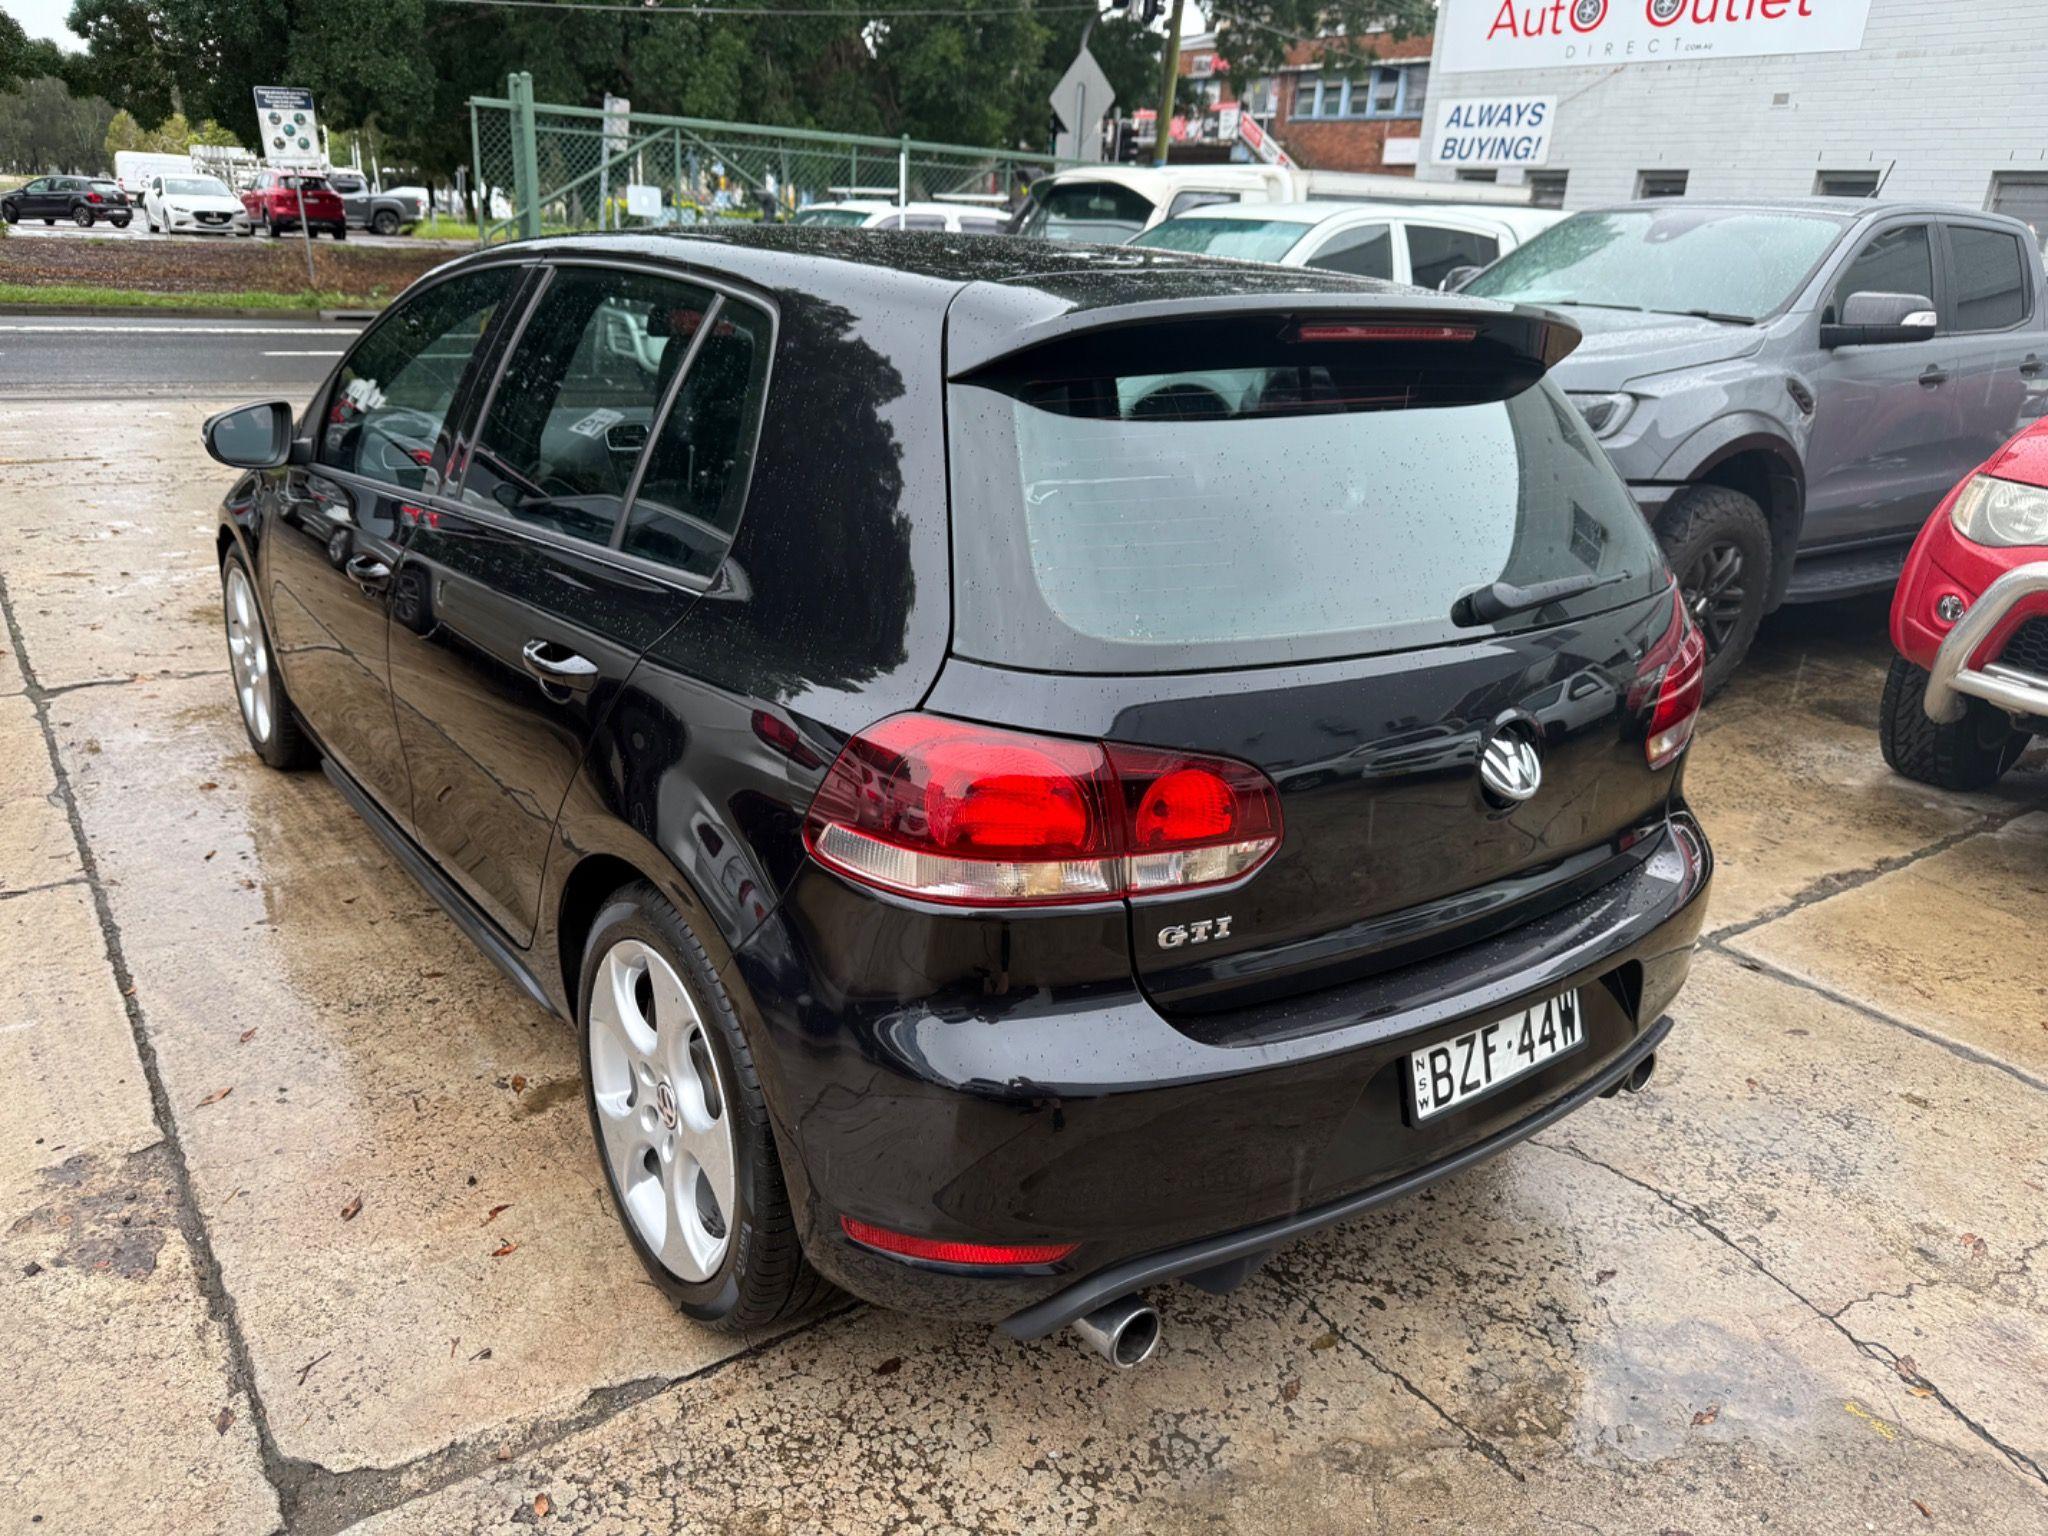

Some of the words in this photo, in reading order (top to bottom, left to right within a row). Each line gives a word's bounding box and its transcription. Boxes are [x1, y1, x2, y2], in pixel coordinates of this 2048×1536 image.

[1445, 102, 1547, 128] ALWAYS
[1440, 136, 1542, 160] BUYING!
[1157, 915, 1233, 950] GTI
